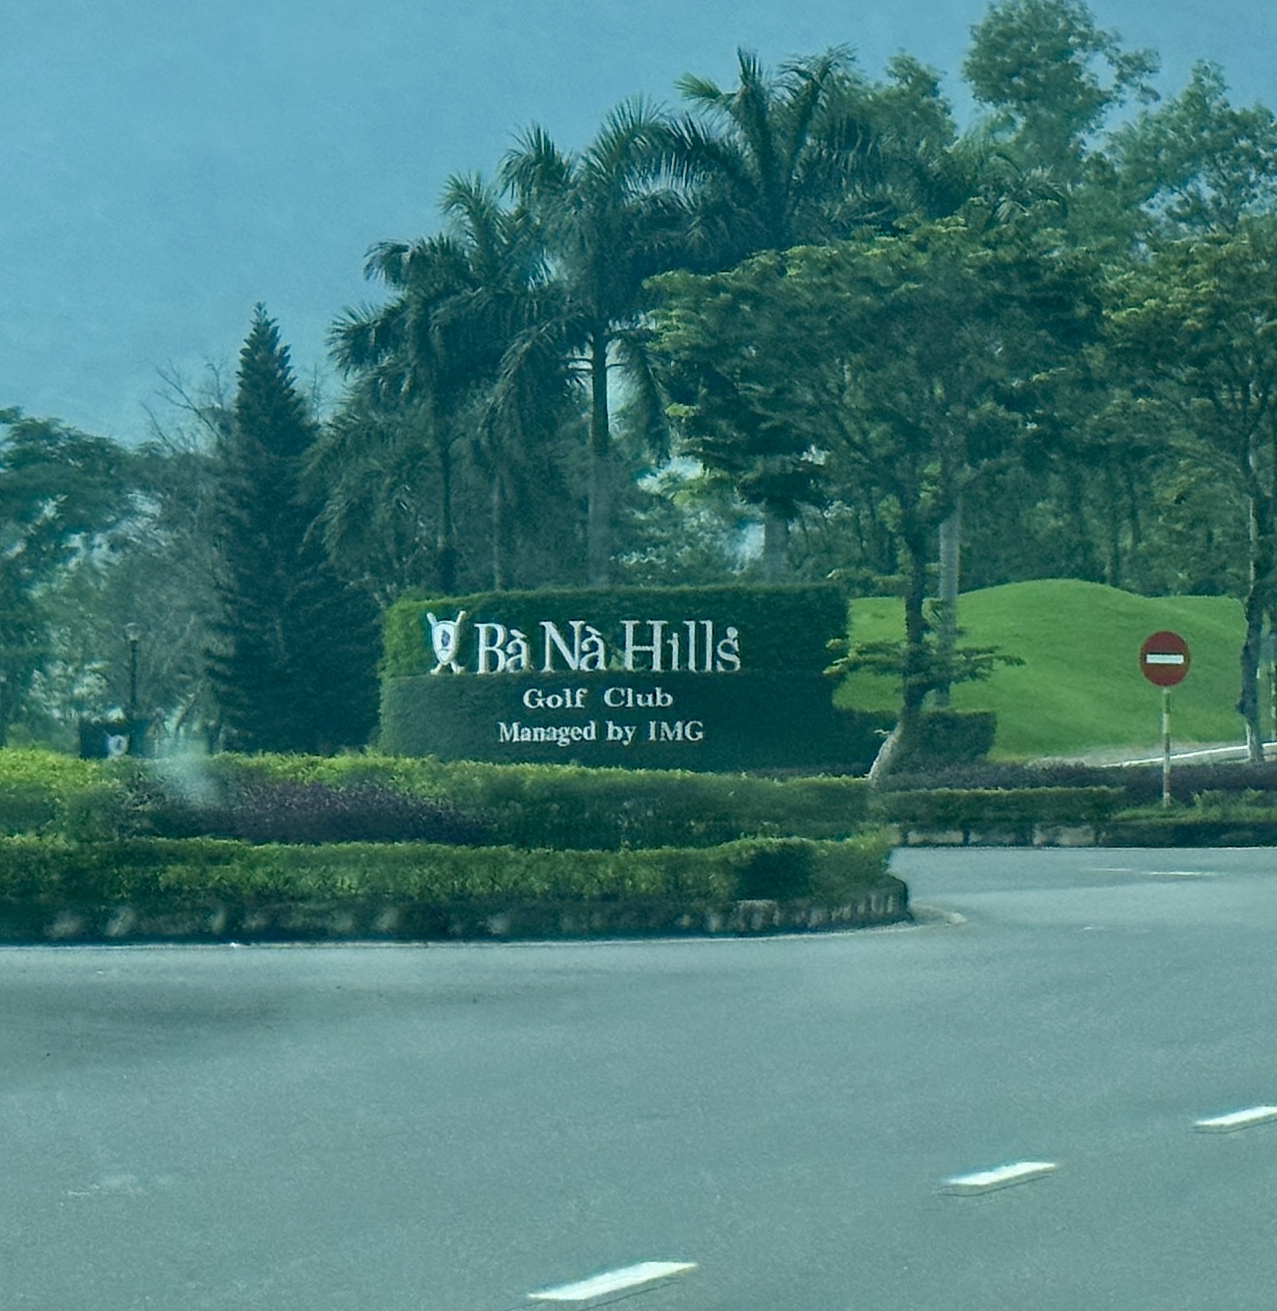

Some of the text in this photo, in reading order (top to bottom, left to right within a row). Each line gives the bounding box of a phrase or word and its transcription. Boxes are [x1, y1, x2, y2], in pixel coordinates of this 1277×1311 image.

[473, 619, 742, 675] Bà Nà Hills
[522, 687, 674, 709] Golf Club
[498, 720, 704, 746] Managed by IMG
